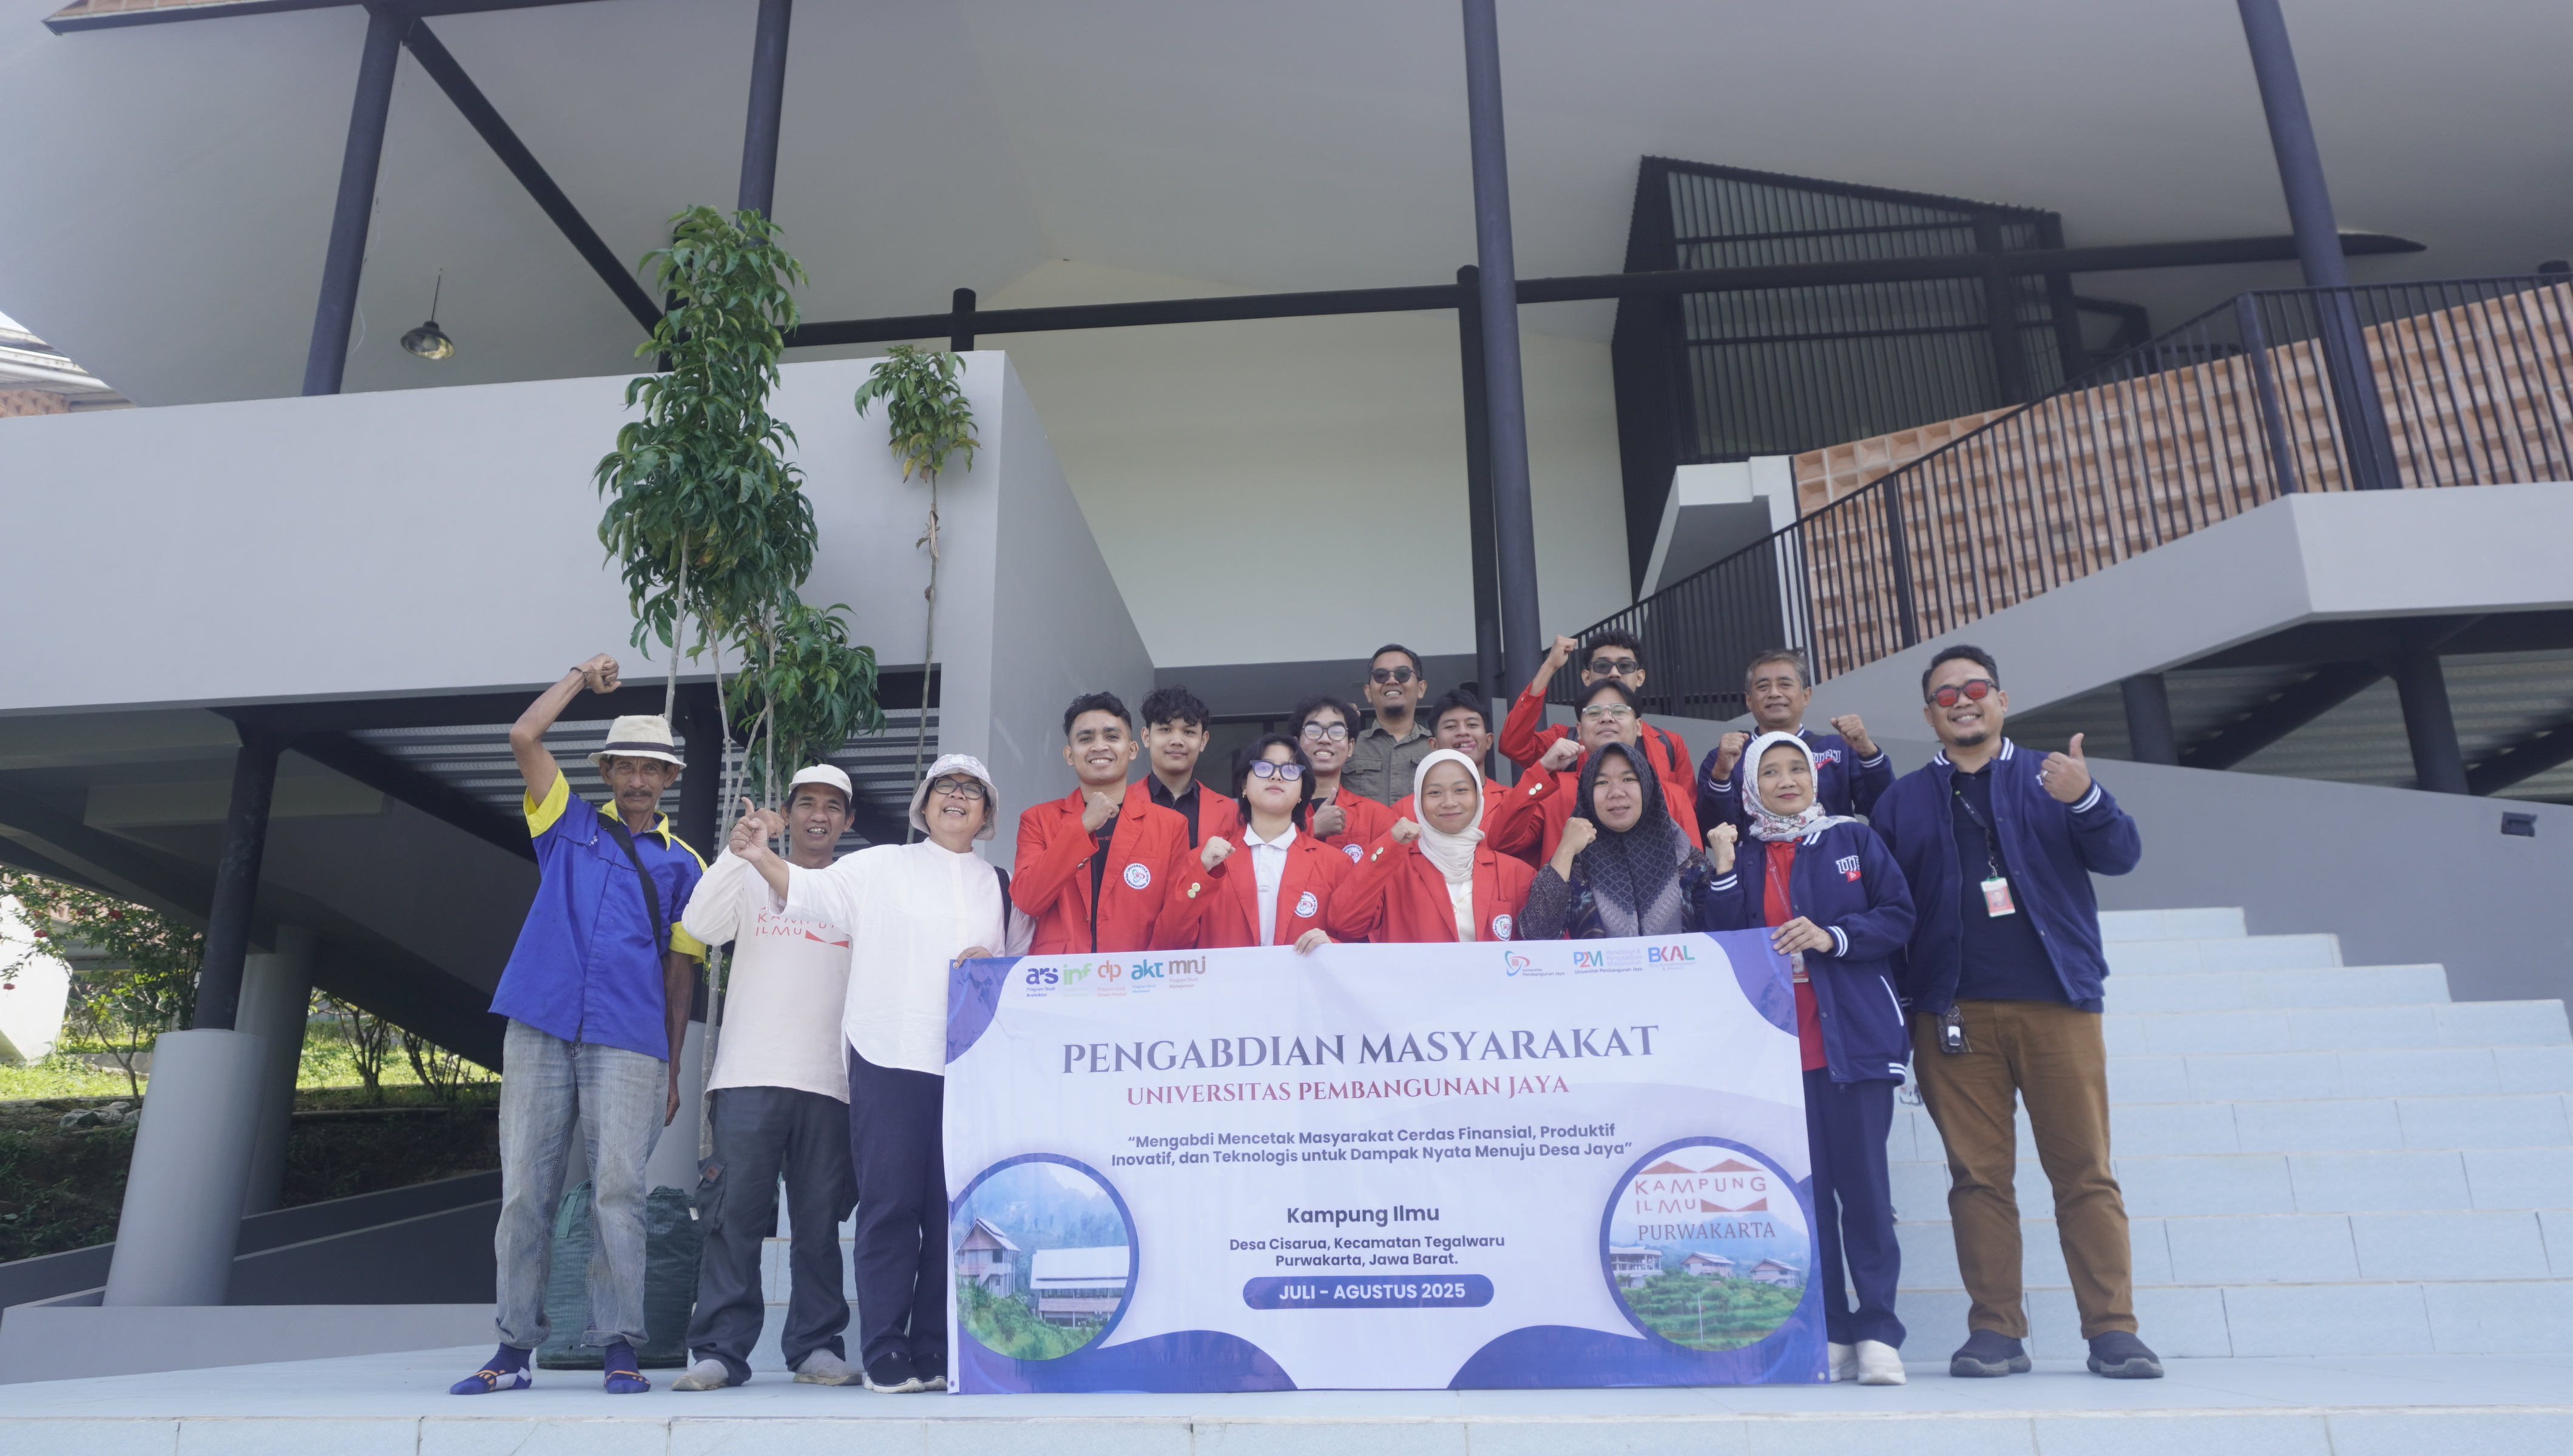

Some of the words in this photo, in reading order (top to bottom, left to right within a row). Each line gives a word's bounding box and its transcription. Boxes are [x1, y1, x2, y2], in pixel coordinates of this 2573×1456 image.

[1836, 855, 1861, 874] UP
[756, 926, 802, 936] ILMU
[1574, 951, 1603, 968] P2M
[1648, 945, 1695, 963] BKAL
[1026, 967, 1059, 985] ars
[1063, 963, 1092, 985] inf
[1097, 960, 1121, 982] dp
[1131, 959, 1164, 980] akt
[1062, 1034, 1345, 1073] PENGABDIAN
[1358, 1025, 1658, 1064] MASYARAKAT
[1127, 1082, 1291, 1105] UNIVERSITAS
[1298, 1077, 1500, 1100] PEMBANGUNAN
[1508, 1075, 1570, 1099] JAYA
[1218, 1132, 1296, 1145] Mencetak
[1299, 1130, 1394, 1147] Masyarakat
[1398, 1128, 1455, 1141] Cerdas
[1459, 1126, 1536, 1140] Finansial,
[1540, 1124, 1615, 1138] Produktif
[1112, 1152, 1175, 1166] Inovatif,
[1179, 1151, 1209, 1164] dan
[1214, 1150, 1298, 1165] Teknologis
[1302, 1148, 1347, 1161] untuk
[1351, 1147, 1419, 1164] Dampak
[1422, 1145, 1472, 1162] Nyata
[1475, 1144, 1535, 1161] Menuju
[1540, 1143, 1578, 1156] Desa
[1635, 1176, 1767, 1195] KAMPUNG
[1287, 1206, 1388, 1228] Kampung
[1393, 1205, 1440, 1221] Ilmu
[1636, 1199, 1696, 1215] ILMU
[1638, 1222, 1776, 1241] PURWAKARTA
[1229, 1238, 1266, 1250] Desa
[1270, 1237, 1331, 1252] Cisarua,
[1334, 1236, 1421, 1249] Kecamatan
[1424, 1235, 1505, 1251] Tegalwaru
[1276, 1253, 1366, 1267] Purwakarta,
[1369, 1253, 1409, 1266] Jawa
[1413, 1252, 1459, 1265] Barat.
[1279, 1284, 1316, 1300] JULI
[1333, 1283, 1418, 1299] AGUSTUS
[1422, 1282, 1466, 1298] 2025
